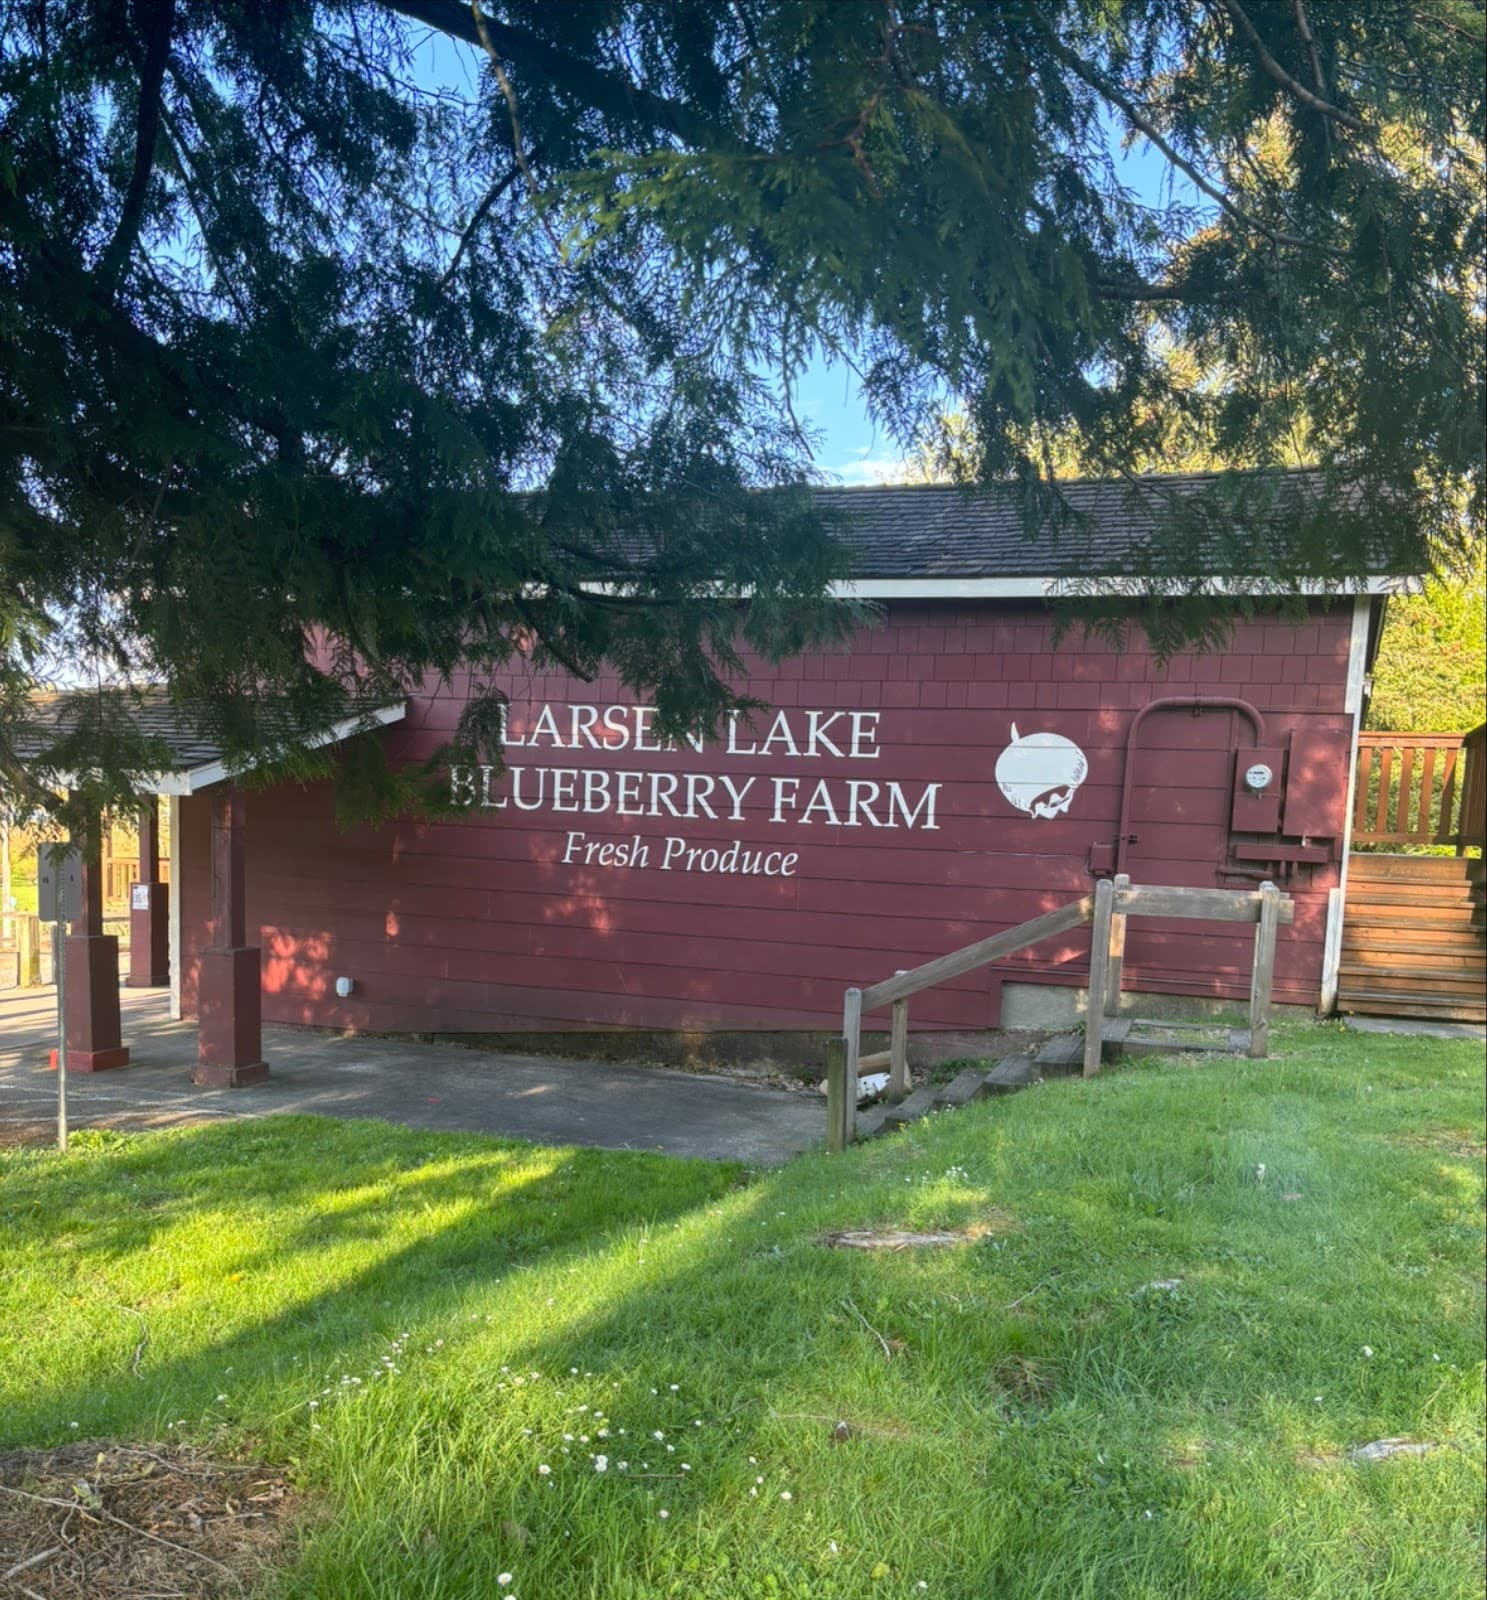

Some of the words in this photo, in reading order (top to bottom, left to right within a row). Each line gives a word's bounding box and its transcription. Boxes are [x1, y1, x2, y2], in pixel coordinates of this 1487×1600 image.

[726, 709, 881, 759] LAKE
[449, 764, 757, 821] BLUEBERRY
[769, 777, 943, 830] FARM
[562, 831, 650, 868] Fresh
[661, 837, 799, 877] Produce
